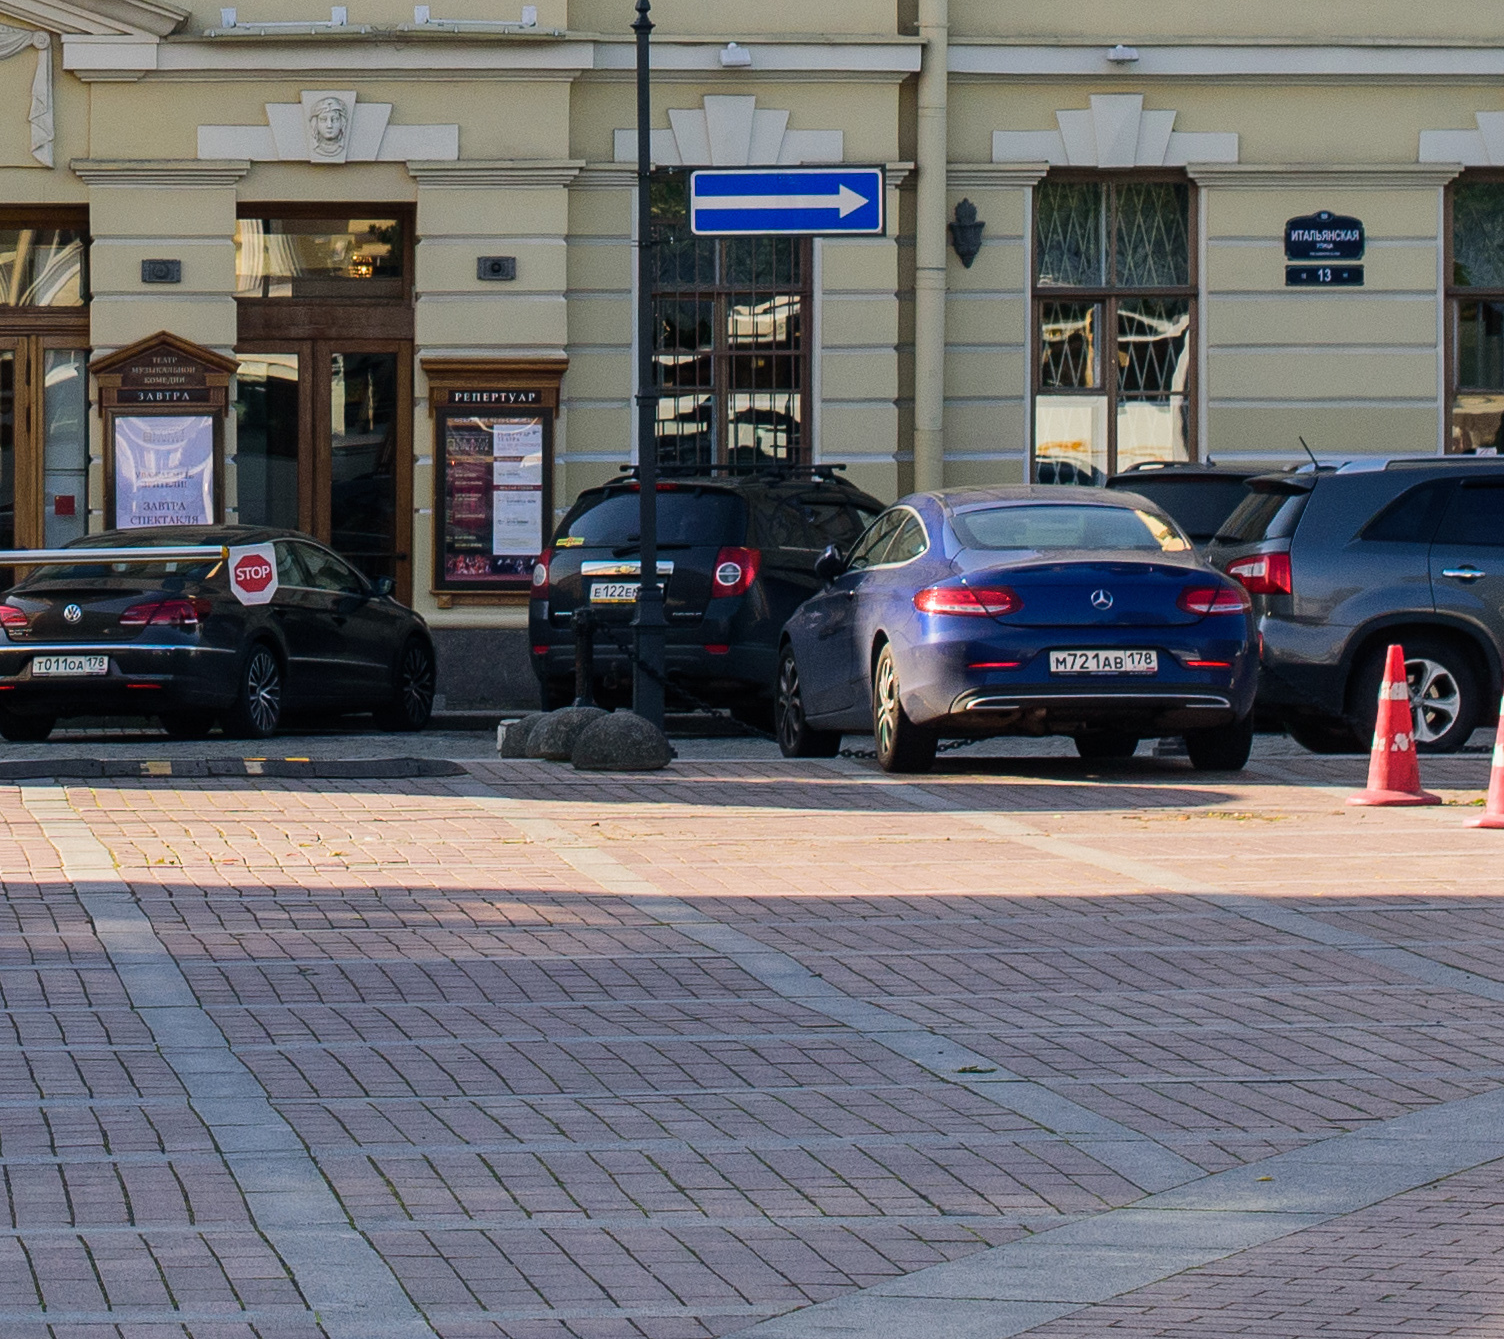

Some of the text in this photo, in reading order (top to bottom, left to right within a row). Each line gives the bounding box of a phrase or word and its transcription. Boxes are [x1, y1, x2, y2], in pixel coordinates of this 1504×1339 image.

[1290, 229, 1360, 242] ИТАЛЬЯНСКАЯ
[1317, 268, 1332, 282] 13
[151, 356, 178, 364] ТЕАТР
[144, 376, 186, 385] КОМЕДИИ
[137, 391, 190, 401] ЗАВТРА
[454, 392, 536, 403] РЕПЕРТУАР
[143, 501, 186, 511] ЗАВТРА
[130, 515, 199, 525] СПЕКТАКЛЯ
[236, 565, 270, 581] STOP
[37, 657, 105, 671] Т011ОА 178
[1055, 651, 1153, 670] М721АВ 178
